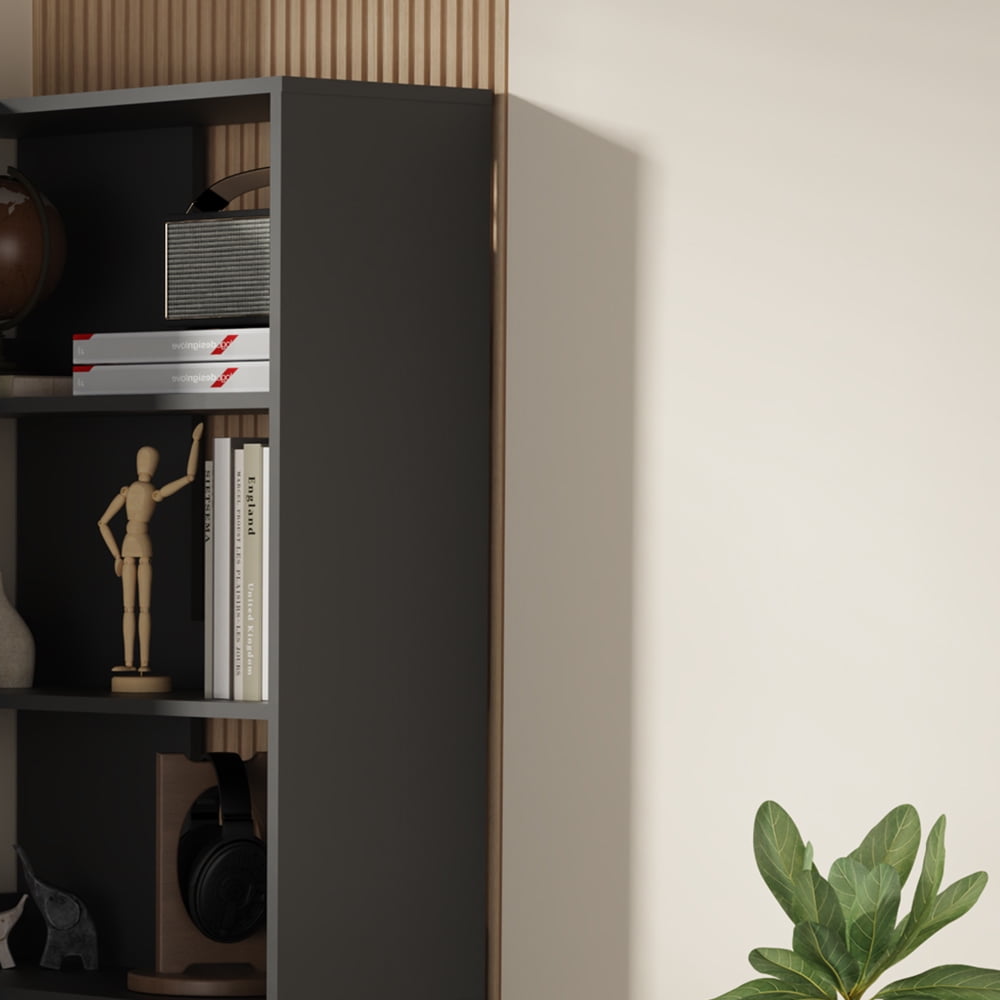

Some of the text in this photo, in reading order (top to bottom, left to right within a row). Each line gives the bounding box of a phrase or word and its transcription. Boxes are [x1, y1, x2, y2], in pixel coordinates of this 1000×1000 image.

[246, 476, 256, 676] England United Kingdom
